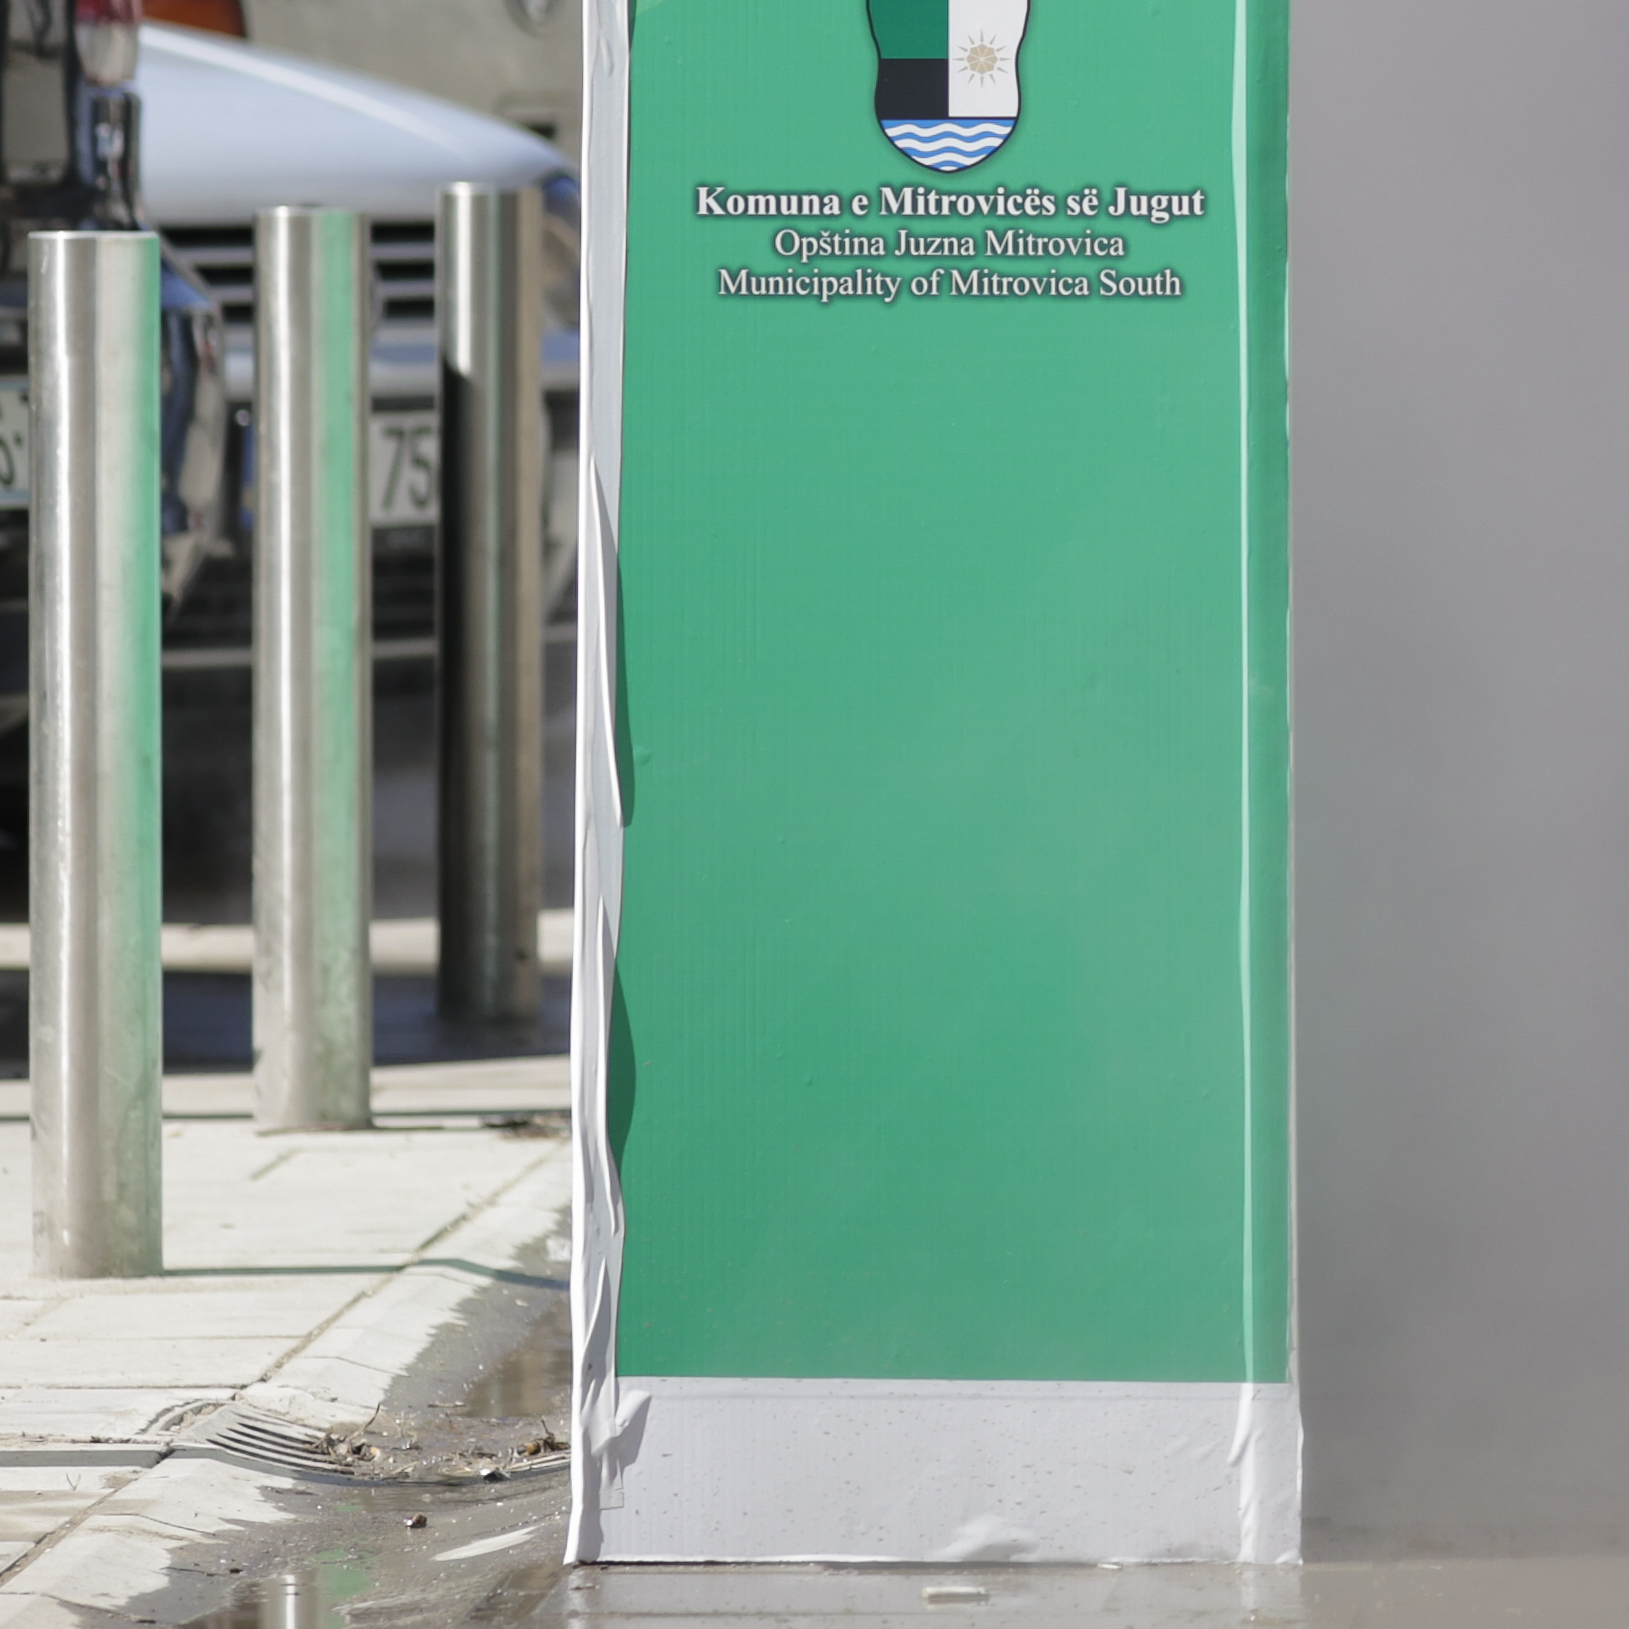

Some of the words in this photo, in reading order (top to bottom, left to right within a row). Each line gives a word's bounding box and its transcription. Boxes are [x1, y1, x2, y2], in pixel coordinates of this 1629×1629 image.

[697, 187, 841, 216] Komuna
[852, 195, 869, 216] e
[880, 186, 1056, 216] Mitrovicës
[1066, 187, 1100, 216] së
[1107, 187, 1204, 225] Jugut
[774, 228, 886, 263] Opština
[894, 229, 976, 257] Juzna
[986, 228, 1125, 257] Mitrovica
[719, 268, 902, 303] Municipality
[910, 268, 946, 296] of
[950, 268, 1090, 296] Mitrovica
[1099, 268, 1181, 296] South
